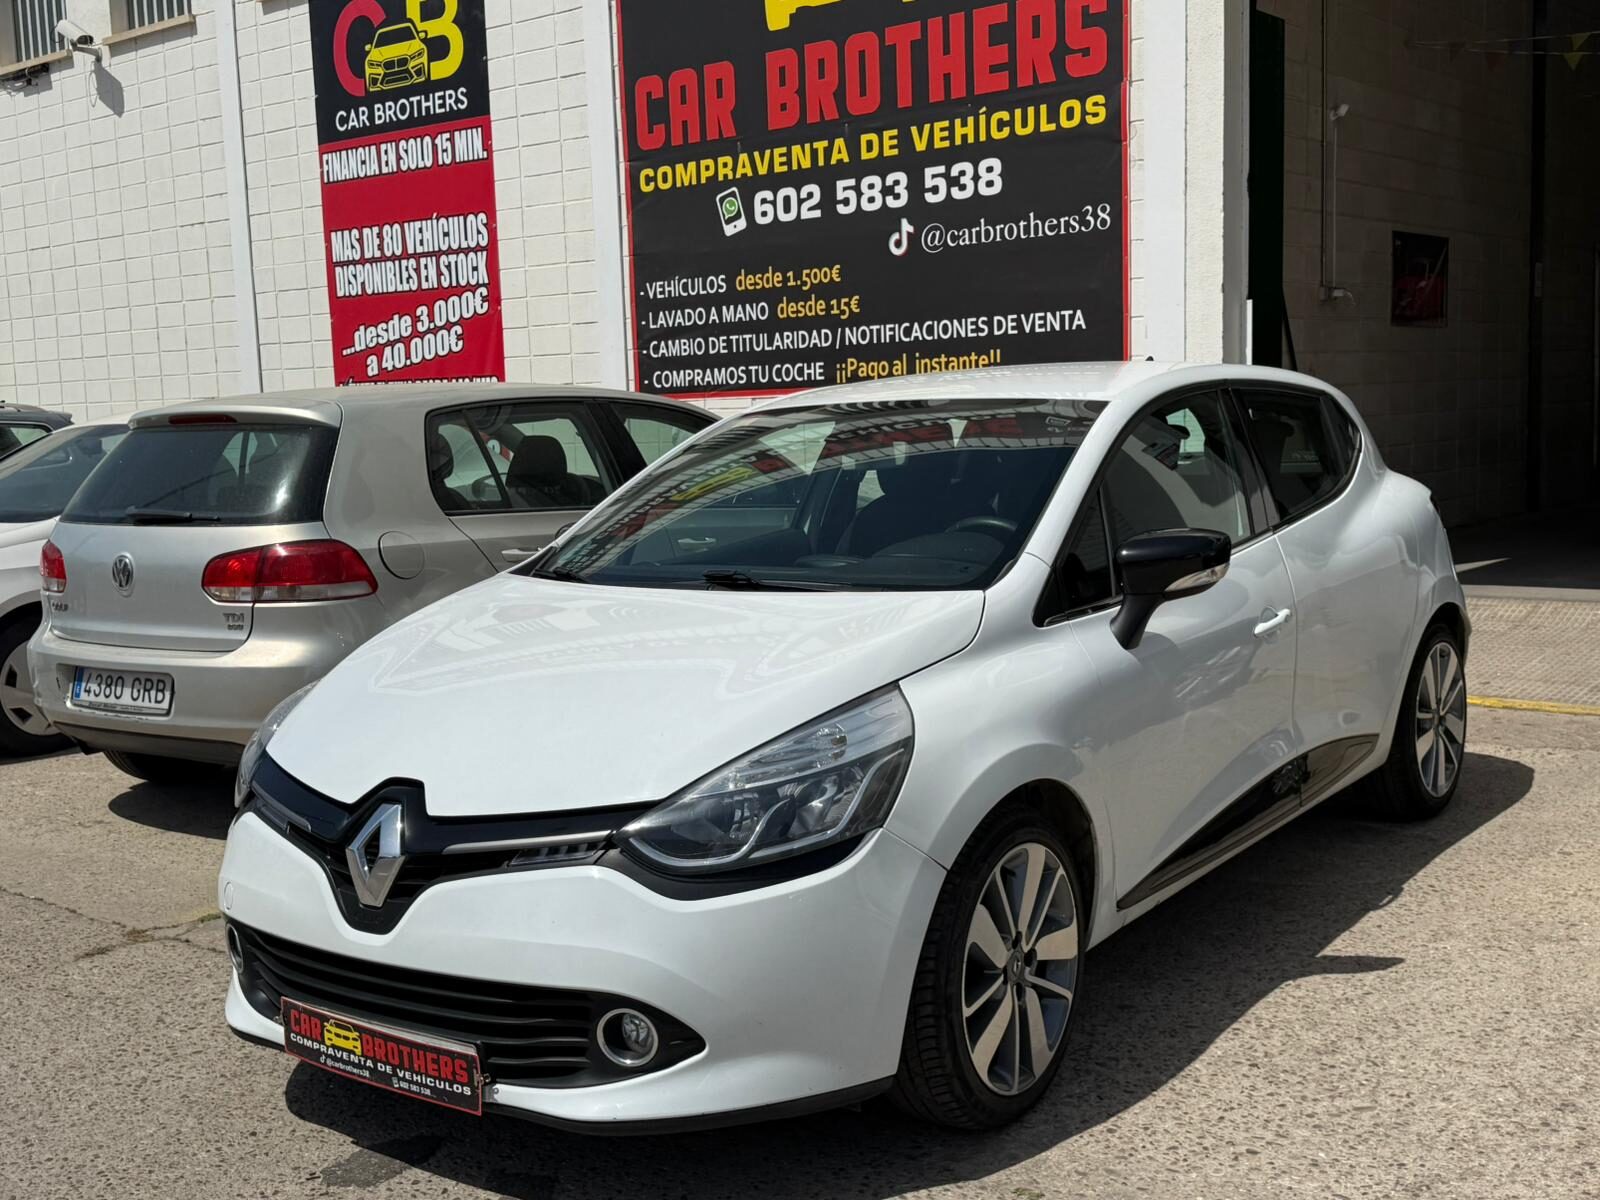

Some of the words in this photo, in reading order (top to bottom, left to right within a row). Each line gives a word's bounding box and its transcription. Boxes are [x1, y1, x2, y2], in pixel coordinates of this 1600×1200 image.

[635, 60, 737, 151] CAR
[765, 0, 1108, 131] BROTHERS
[335, 106, 370, 131] CAR
[374, 87, 468, 125] BROTHERS
[322, 145, 379, 183] FINANCIA
[380, 142, 397, 174] EN
[399, 135, 433, 172] SOLO
[435, 132, 452, 165] 15
[454, 127, 488, 163] MIN.
[639, 137, 850, 193] COMPRAVENTA
[860, 128, 899, 160] DE
[910, 94, 1107, 152] VEHÍCULOS
[753, 183, 822, 225] 602
[835, 171, 909, 215] 583
[923, 157, 1003, 204] 538
[330, 228, 361, 263] MAS
[362, 226, 381, 259] DE
[382, 223, 402, 257] 80
[404, 212, 489, 254] VEHÍCULOS
[921, 203, 1112, 253] @carbrothers38
[334, 257, 418, 297] DISPONIBLES
[419, 256, 438, 290] EN
[439, 251, 489, 288] STOCK
[646, 275, 727, 300] VEHÍCULOS
[735, 266, 783, 292] desde
[786, 265, 841, 291] 1.500€
[415, 287, 489, 332] 3.000€
[648, 307, 706, 329] LAVADO
[708, 306, 720, 324] A
[722, 302, 769, 322] MANO
[777, 294, 826, 319] desde
[830, 295, 861, 320] 15€
[649, 337, 705, 358] CAMBIO
[709, 336, 728, 354] DE
[729, 328, 833, 353] TITULARIDAD
[835, 328, 842, 350] /
[844, 317, 989, 346] NOTIFICACIONES
[993, 314, 1018, 336] DE
[1020, 309, 1087, 333] VENTA
[366, 354, 379, 377] a
[381, 325, 464, 372] 40.000€
[652, 366, 747, 388] COMPRAMOS
[748, 365, 769, 384] TU
[772, 362, 825, 382] COCHE
[892, 353, 908, 376] al
[84, 672, 125, 700] 4380
[130, 677, 167, 704] GRB
[290, 1009, 322, 1041] CAR
[362, 1033, 469, 1083] BROTHERS
[290, 1033, 374, 1068] COMPRAVENTA
[377, 1062, 393, 1074] DE
